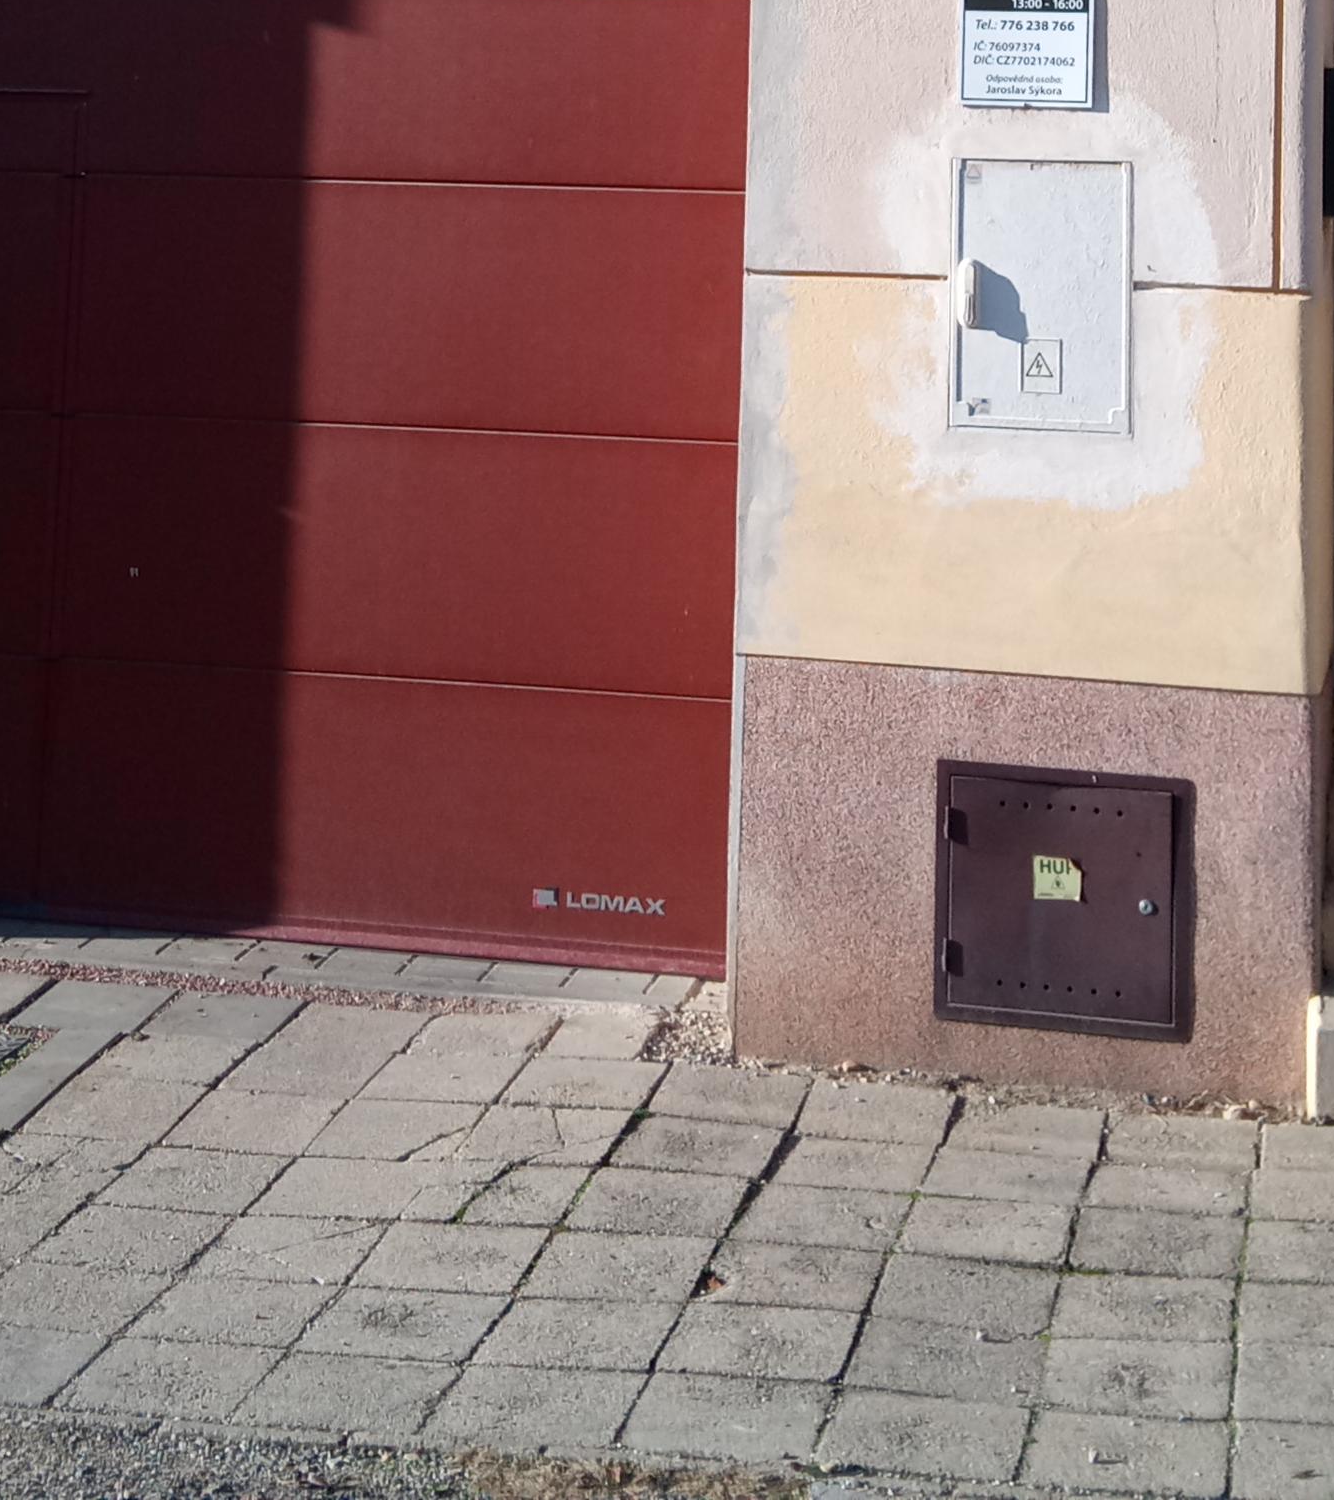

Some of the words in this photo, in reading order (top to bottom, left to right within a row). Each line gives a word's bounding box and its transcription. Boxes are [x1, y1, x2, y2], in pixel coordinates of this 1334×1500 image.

[1053, 0, 1084, 10] 16:00
[1000, 20, 1023, 31] 776
[1026, 20, 1049, 31] 238
[1052, 21, 1075, 32] 766
[989, 42, 1041, 52] 76097374
[986, 85, 1026, 95] Jaroslav
[1028, 86, 1063, 97] Sýkora
[566, 891, 666, 916] LOMAX
